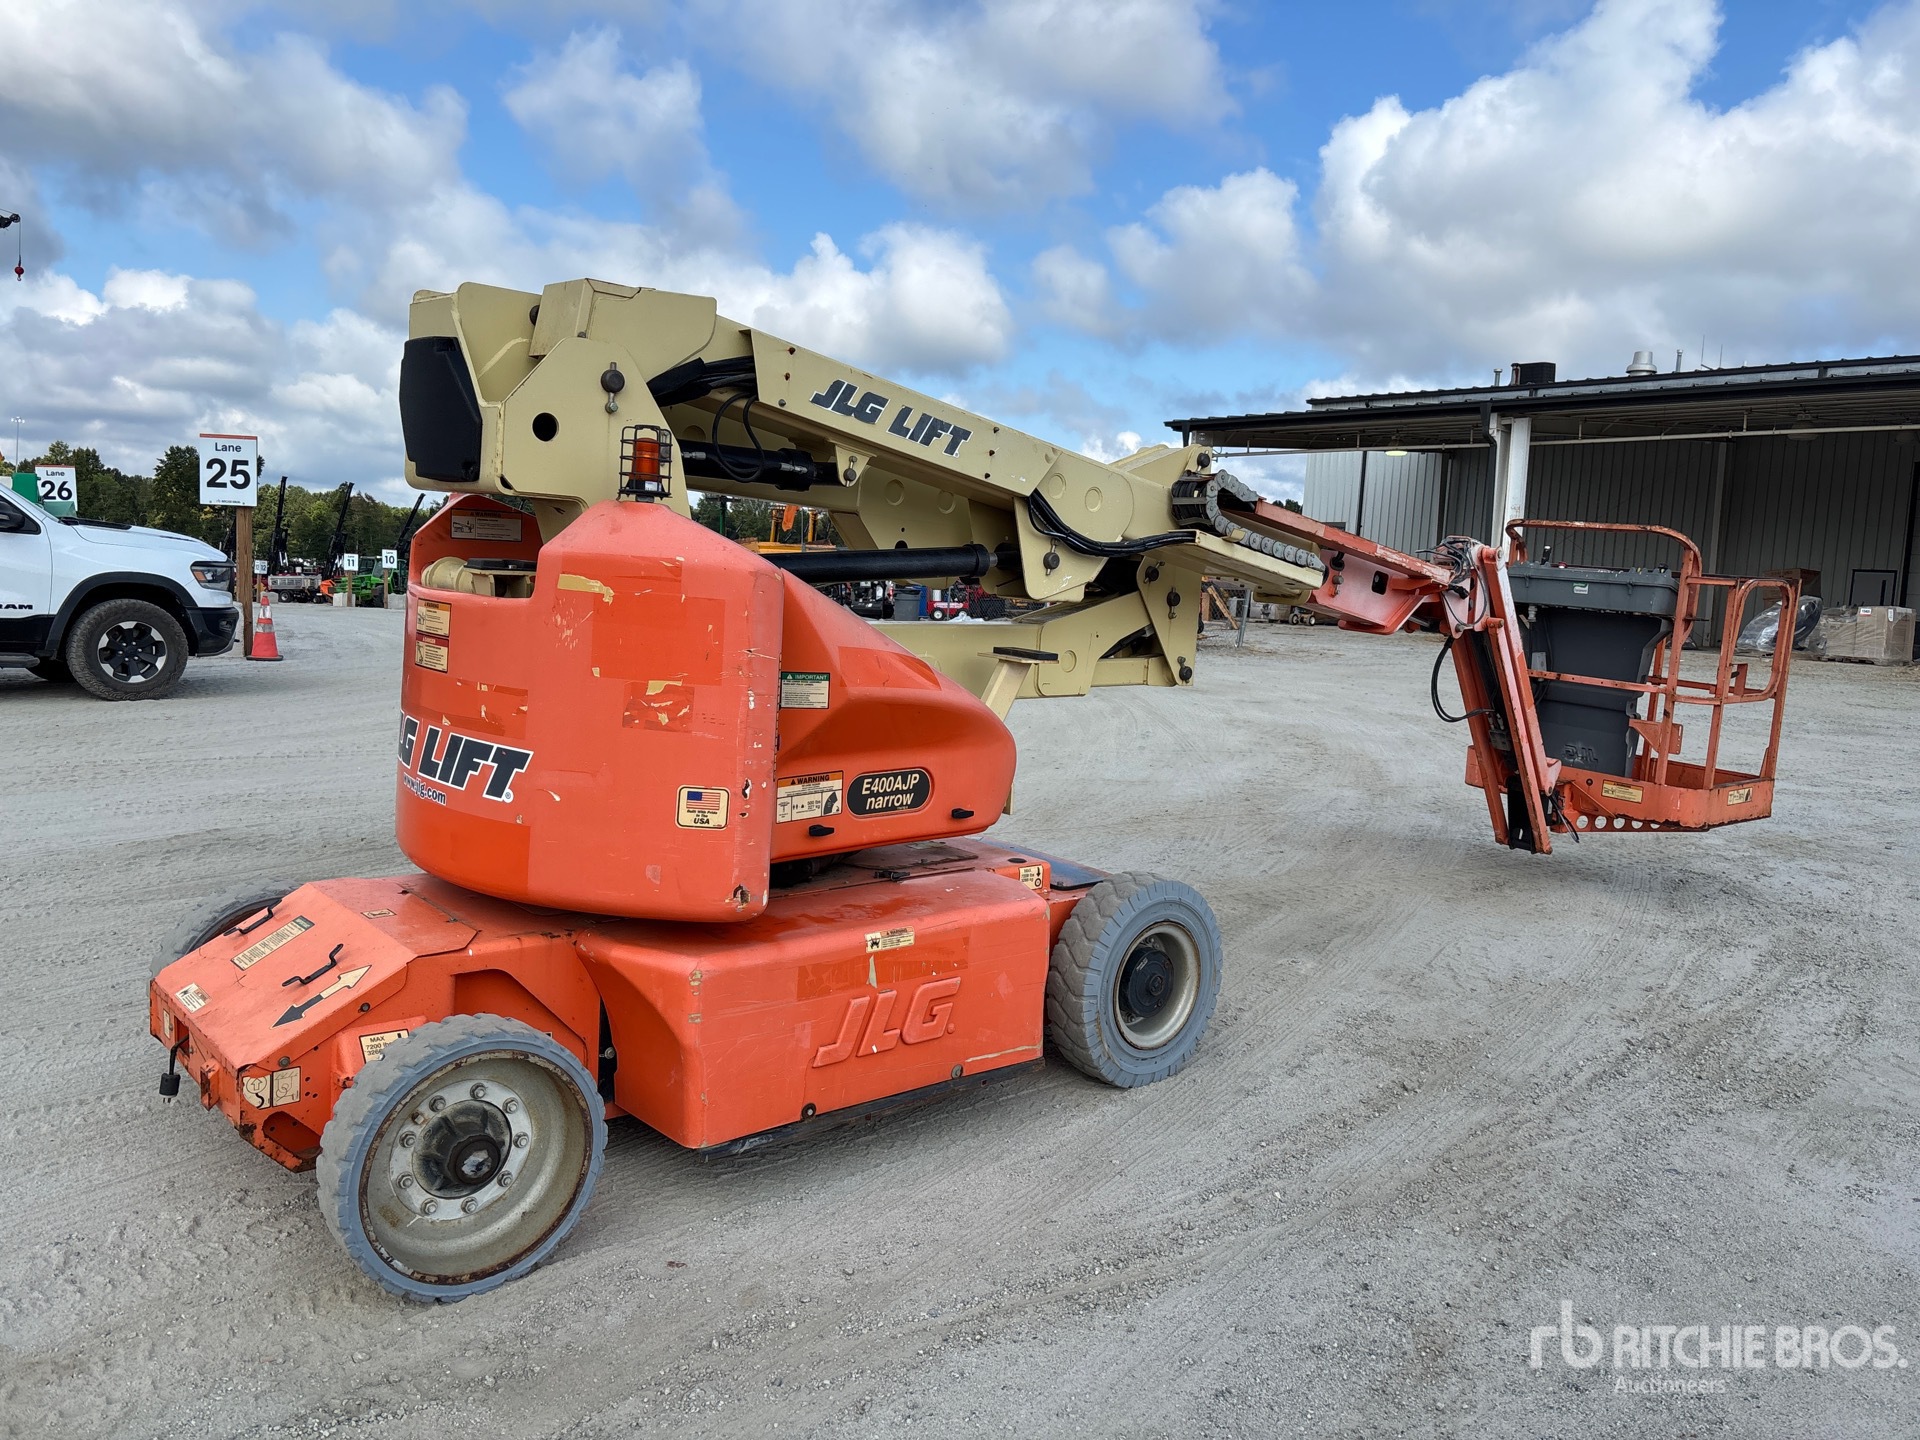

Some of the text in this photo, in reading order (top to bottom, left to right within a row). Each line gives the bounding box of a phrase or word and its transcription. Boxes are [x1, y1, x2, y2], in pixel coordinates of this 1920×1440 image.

[809, 379, 890, 425] JLG
[214, 442, 242, 453] Lane
[45, 469, 66, 477] Lane
[206, 458, 251, 490] 25
[40, 480, 73, 501] 26
[347, 558, 355, 567] 11
[384, 555, 395, 565] 10
[797, 774, 830, 785] WARNING
[861, 773, 920, 795] E400AJP
[865, 793, 915, 810] narrow
[693, 817, 710, 825] USA
[369, 1035, 386, 1043] MAX
